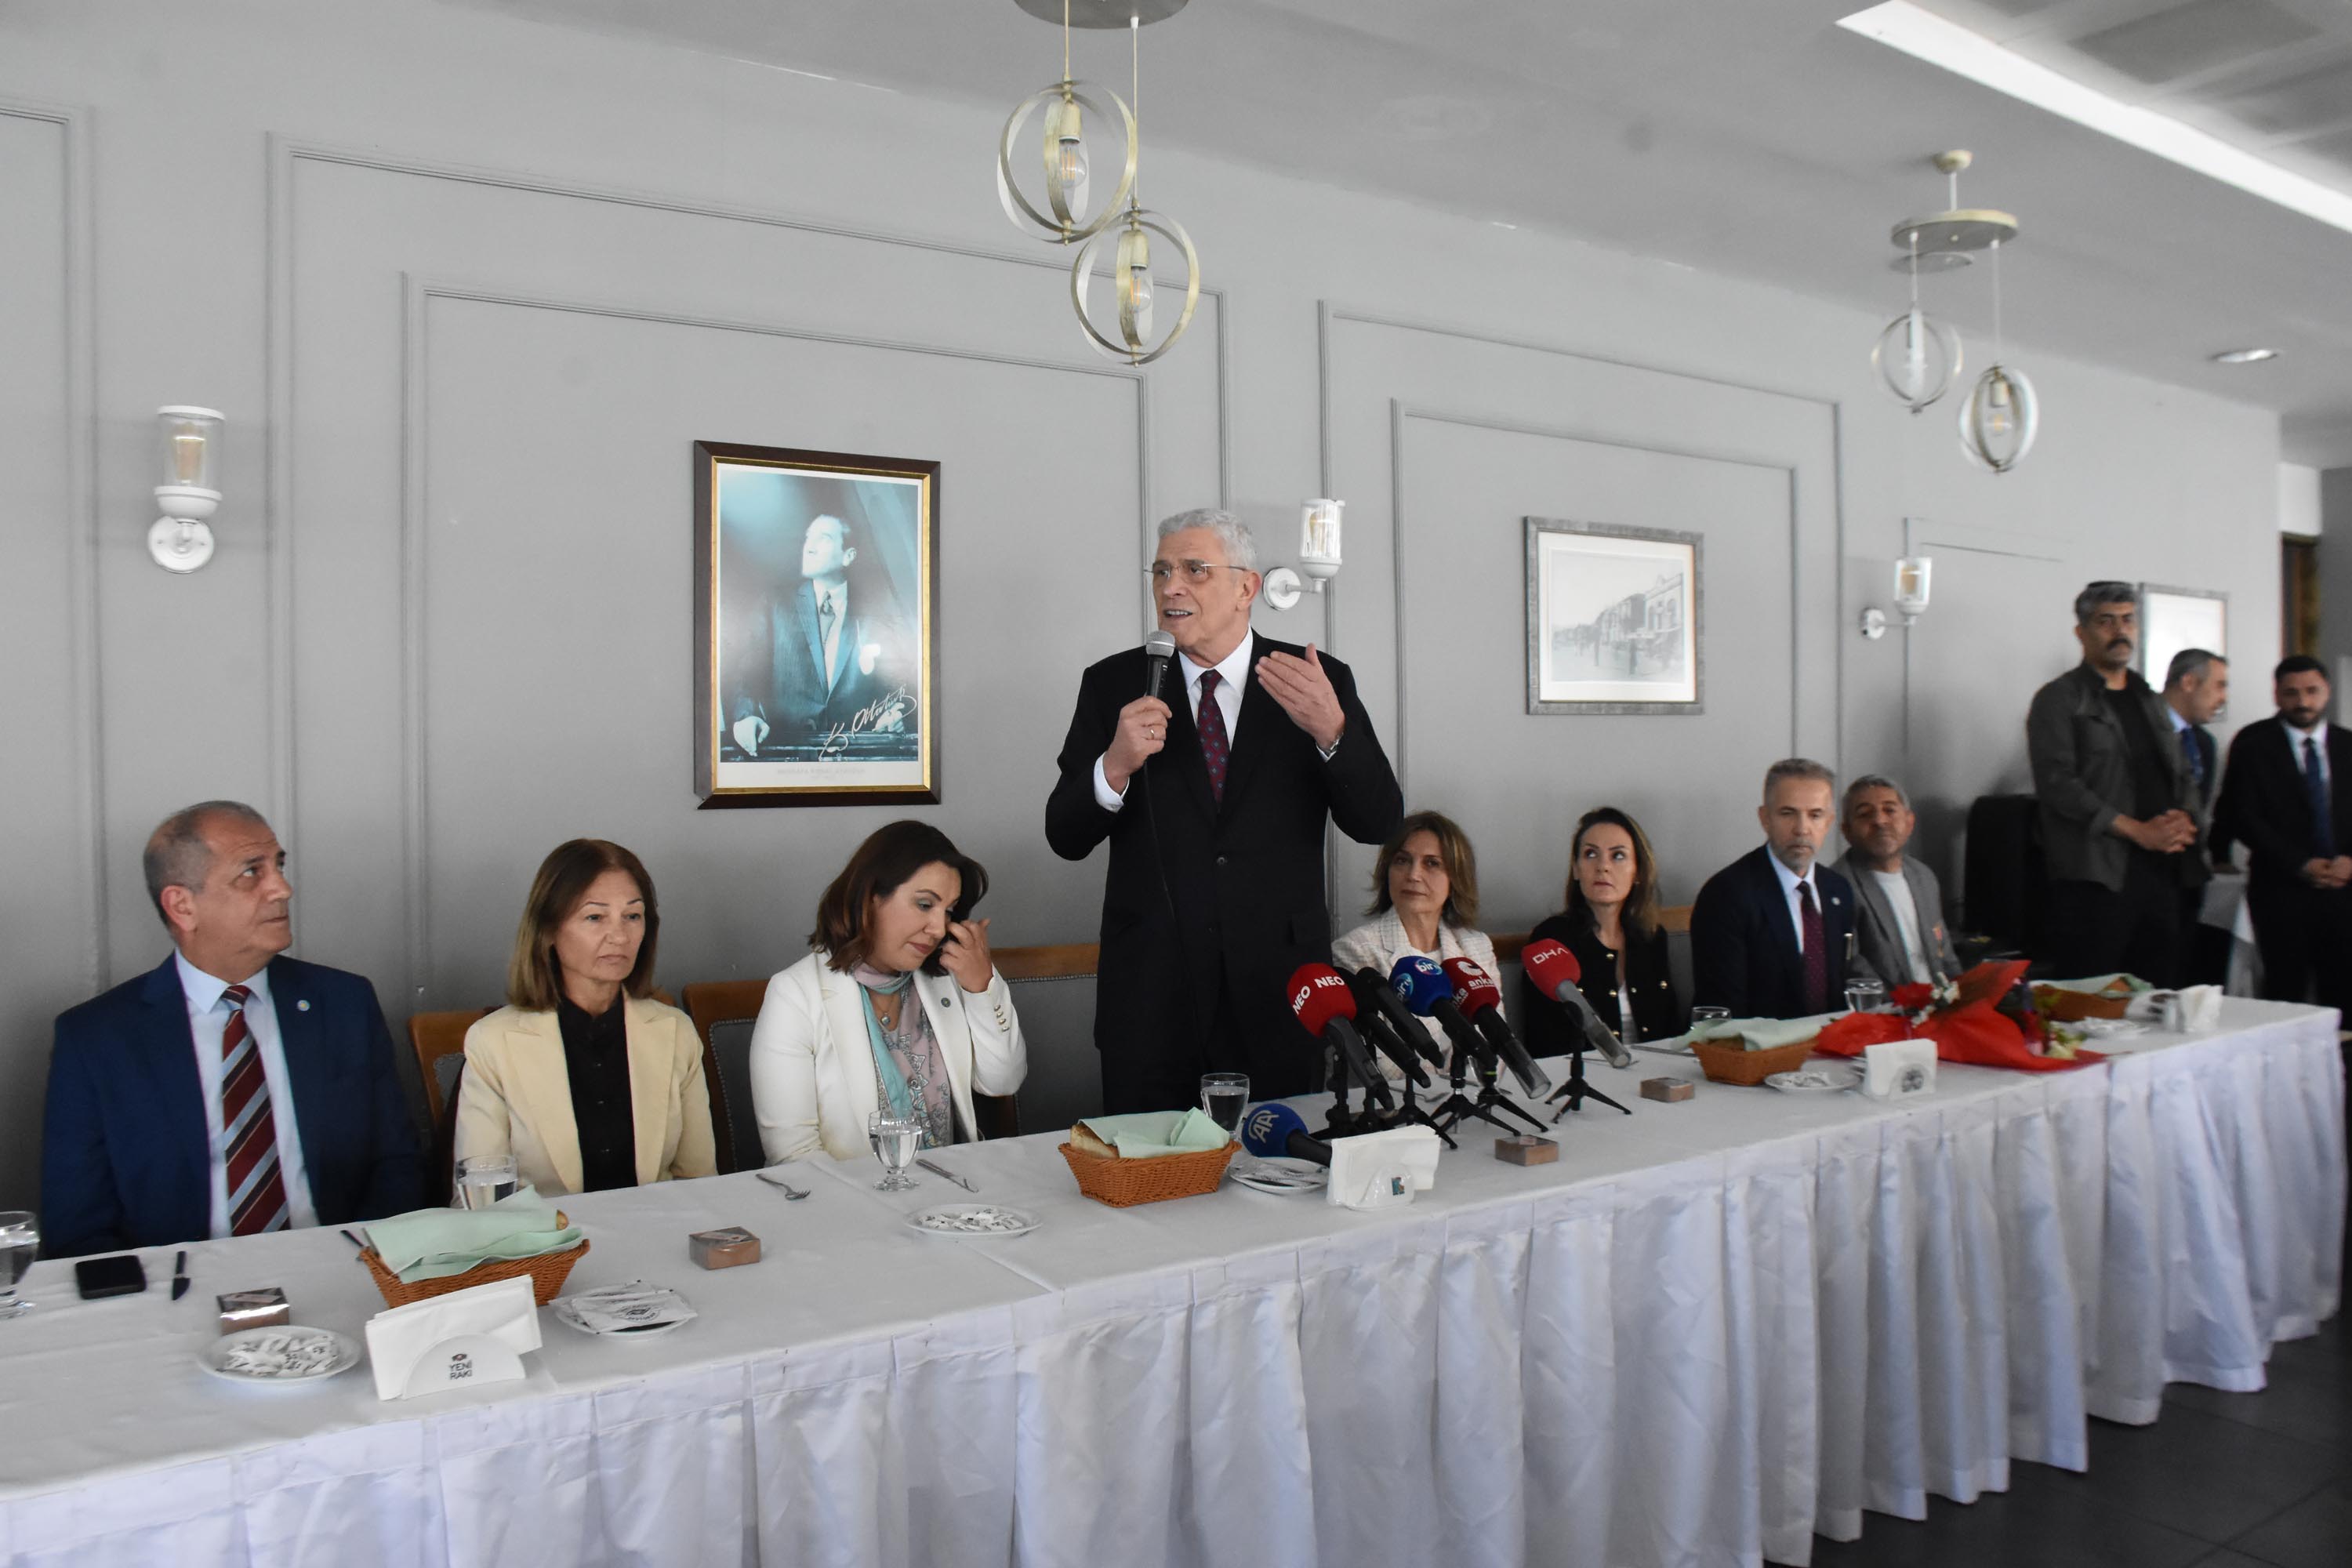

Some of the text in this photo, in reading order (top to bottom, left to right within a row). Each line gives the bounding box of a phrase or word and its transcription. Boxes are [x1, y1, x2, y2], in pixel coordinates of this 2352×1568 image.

[1532, 947, 1568, 964] DHA
[1314, 976, 1345, 988] NEO
[1468, 976, 1494, 987] anka
[1292, 985, 1310, 1016] NEO
[1253, 1114, 1279, 1144] AA
